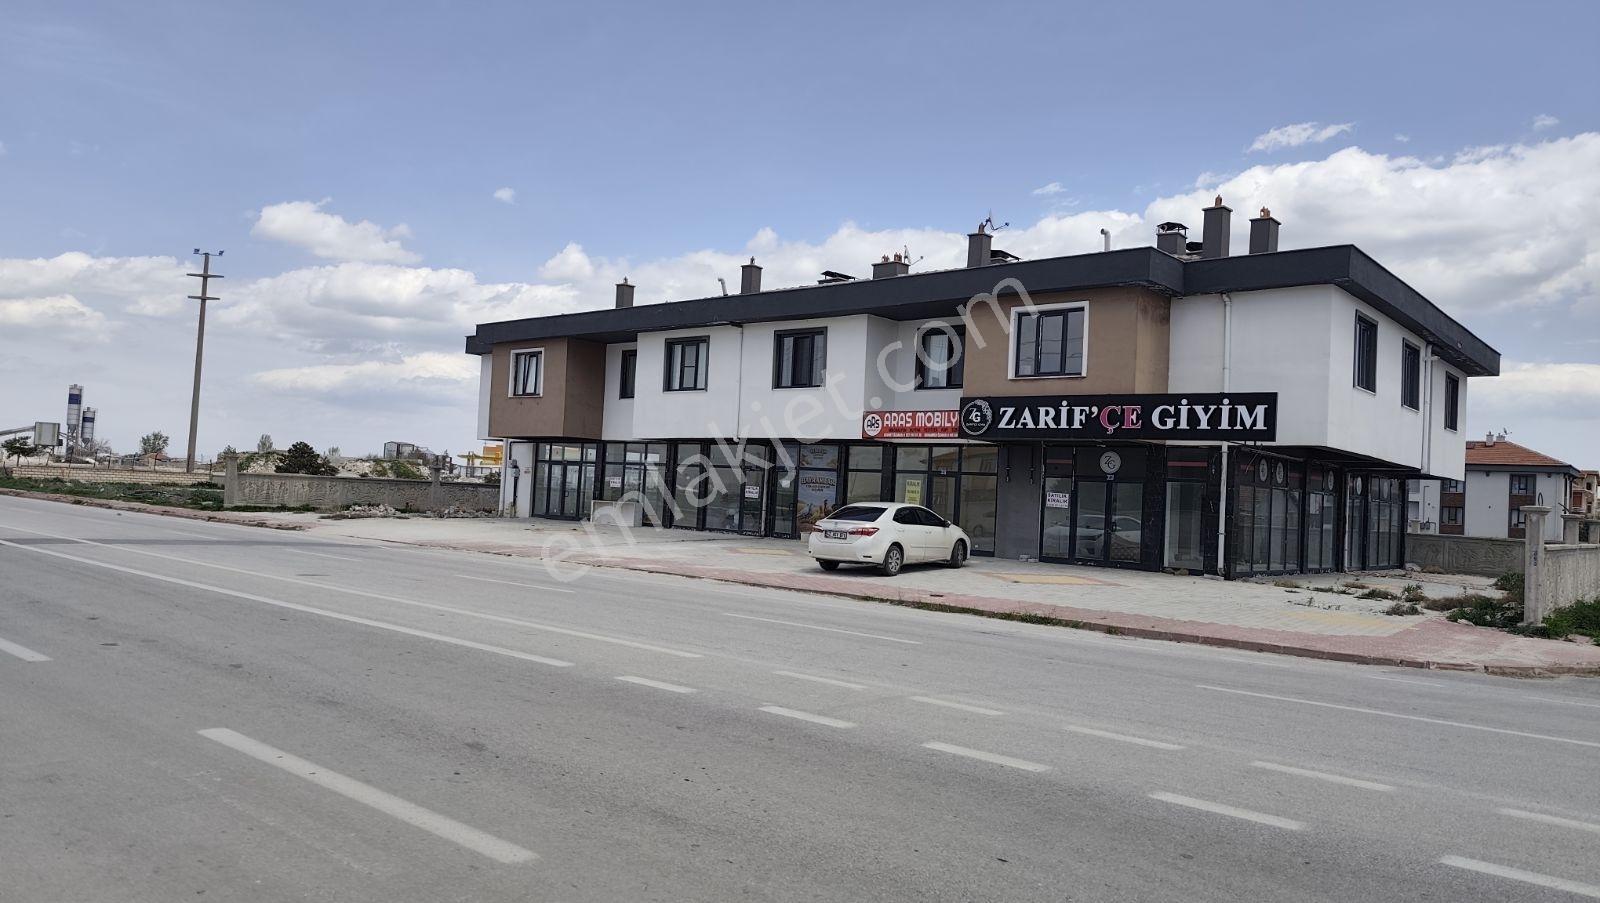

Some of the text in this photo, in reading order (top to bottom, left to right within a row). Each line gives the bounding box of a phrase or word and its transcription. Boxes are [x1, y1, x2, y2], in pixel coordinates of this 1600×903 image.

[884, 412, 960, 427] ARAS MOBILY
[1151, 398, 1268, 430] GİYİM
